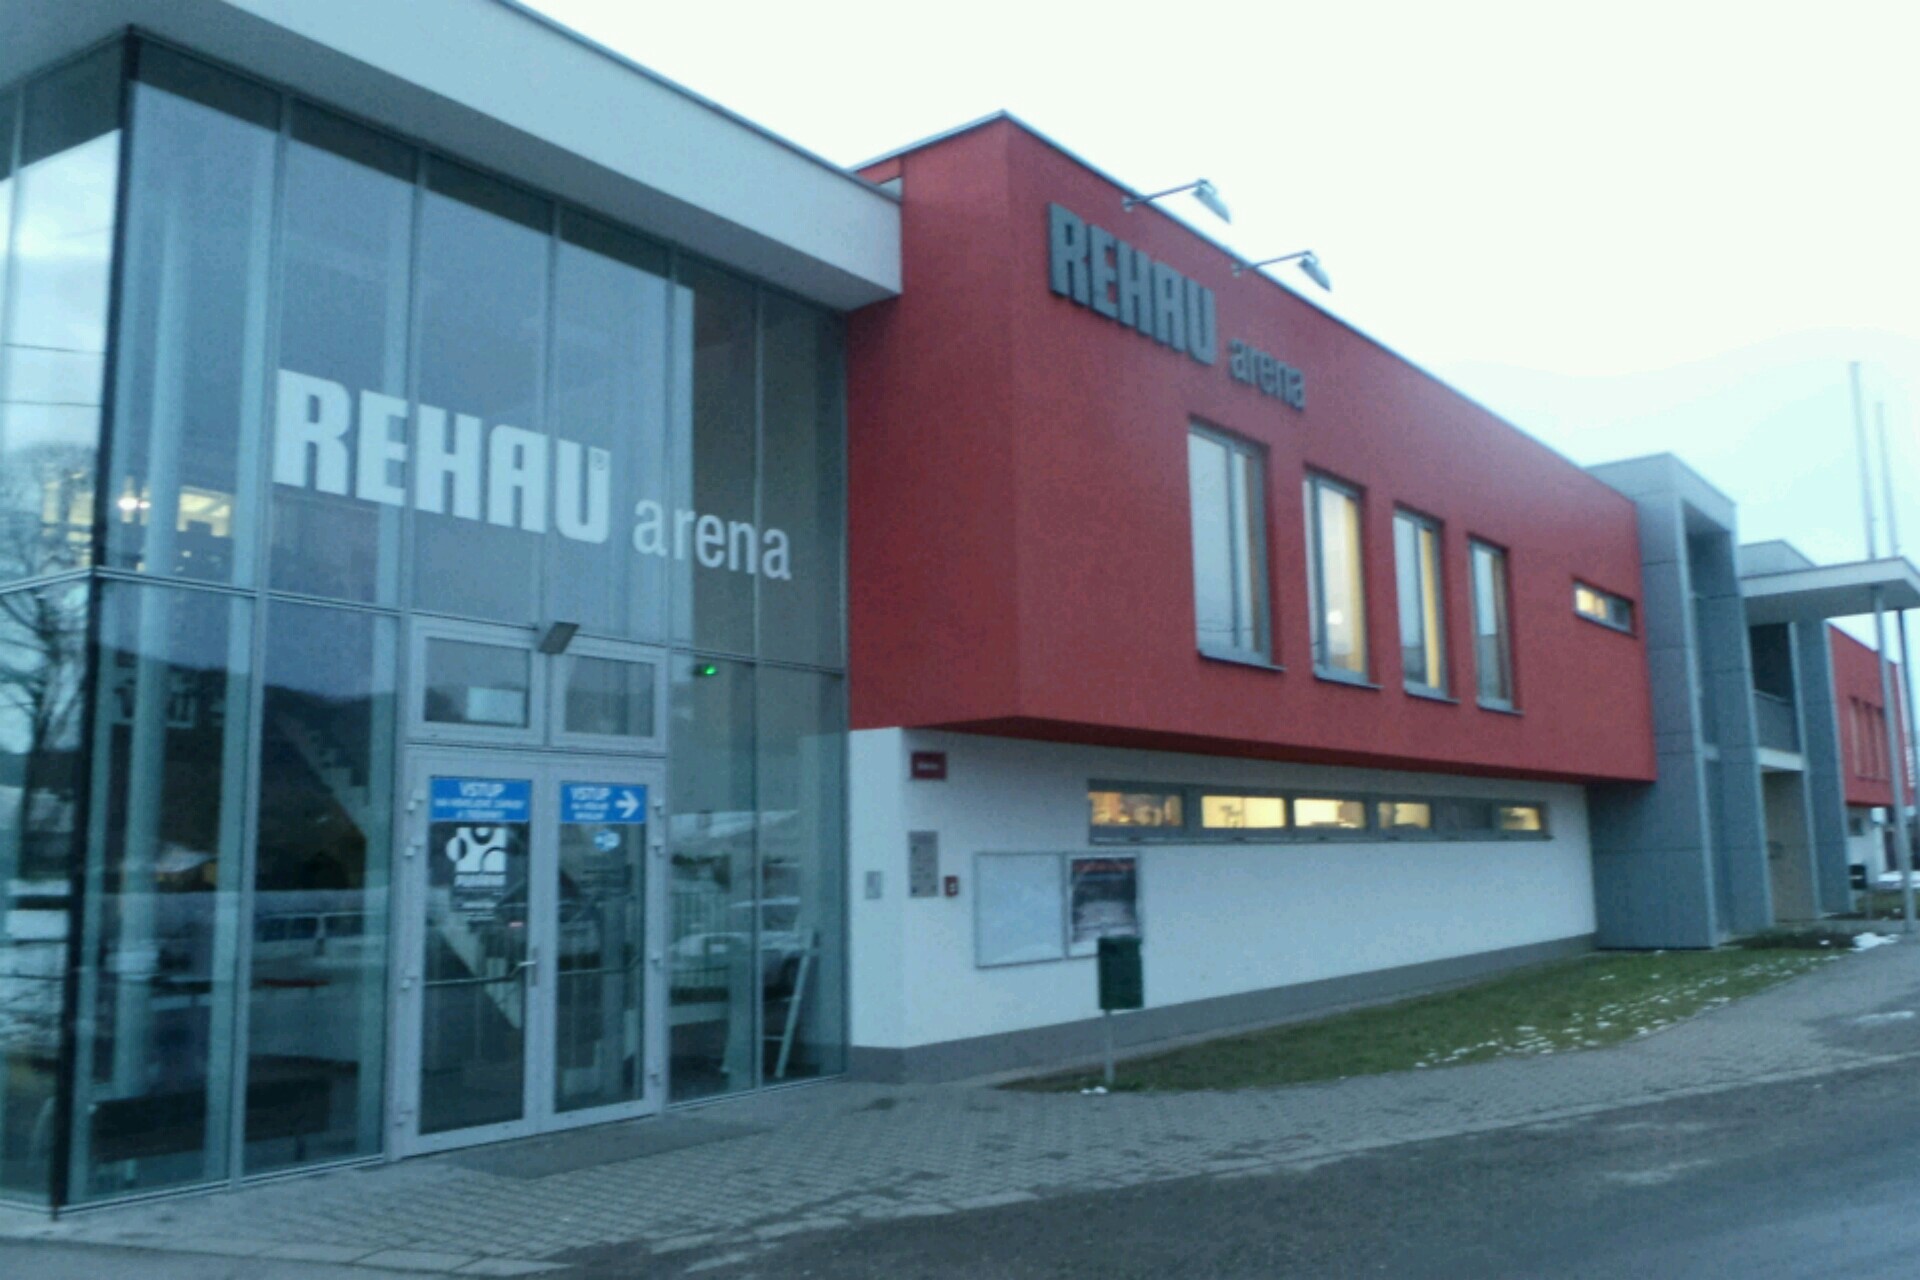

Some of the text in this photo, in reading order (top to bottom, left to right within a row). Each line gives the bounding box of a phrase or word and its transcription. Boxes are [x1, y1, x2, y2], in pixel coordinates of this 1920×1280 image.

[1048, 202, 1306, 412] REHAU arena
[272, 368, 792, 581] REHAU arena
